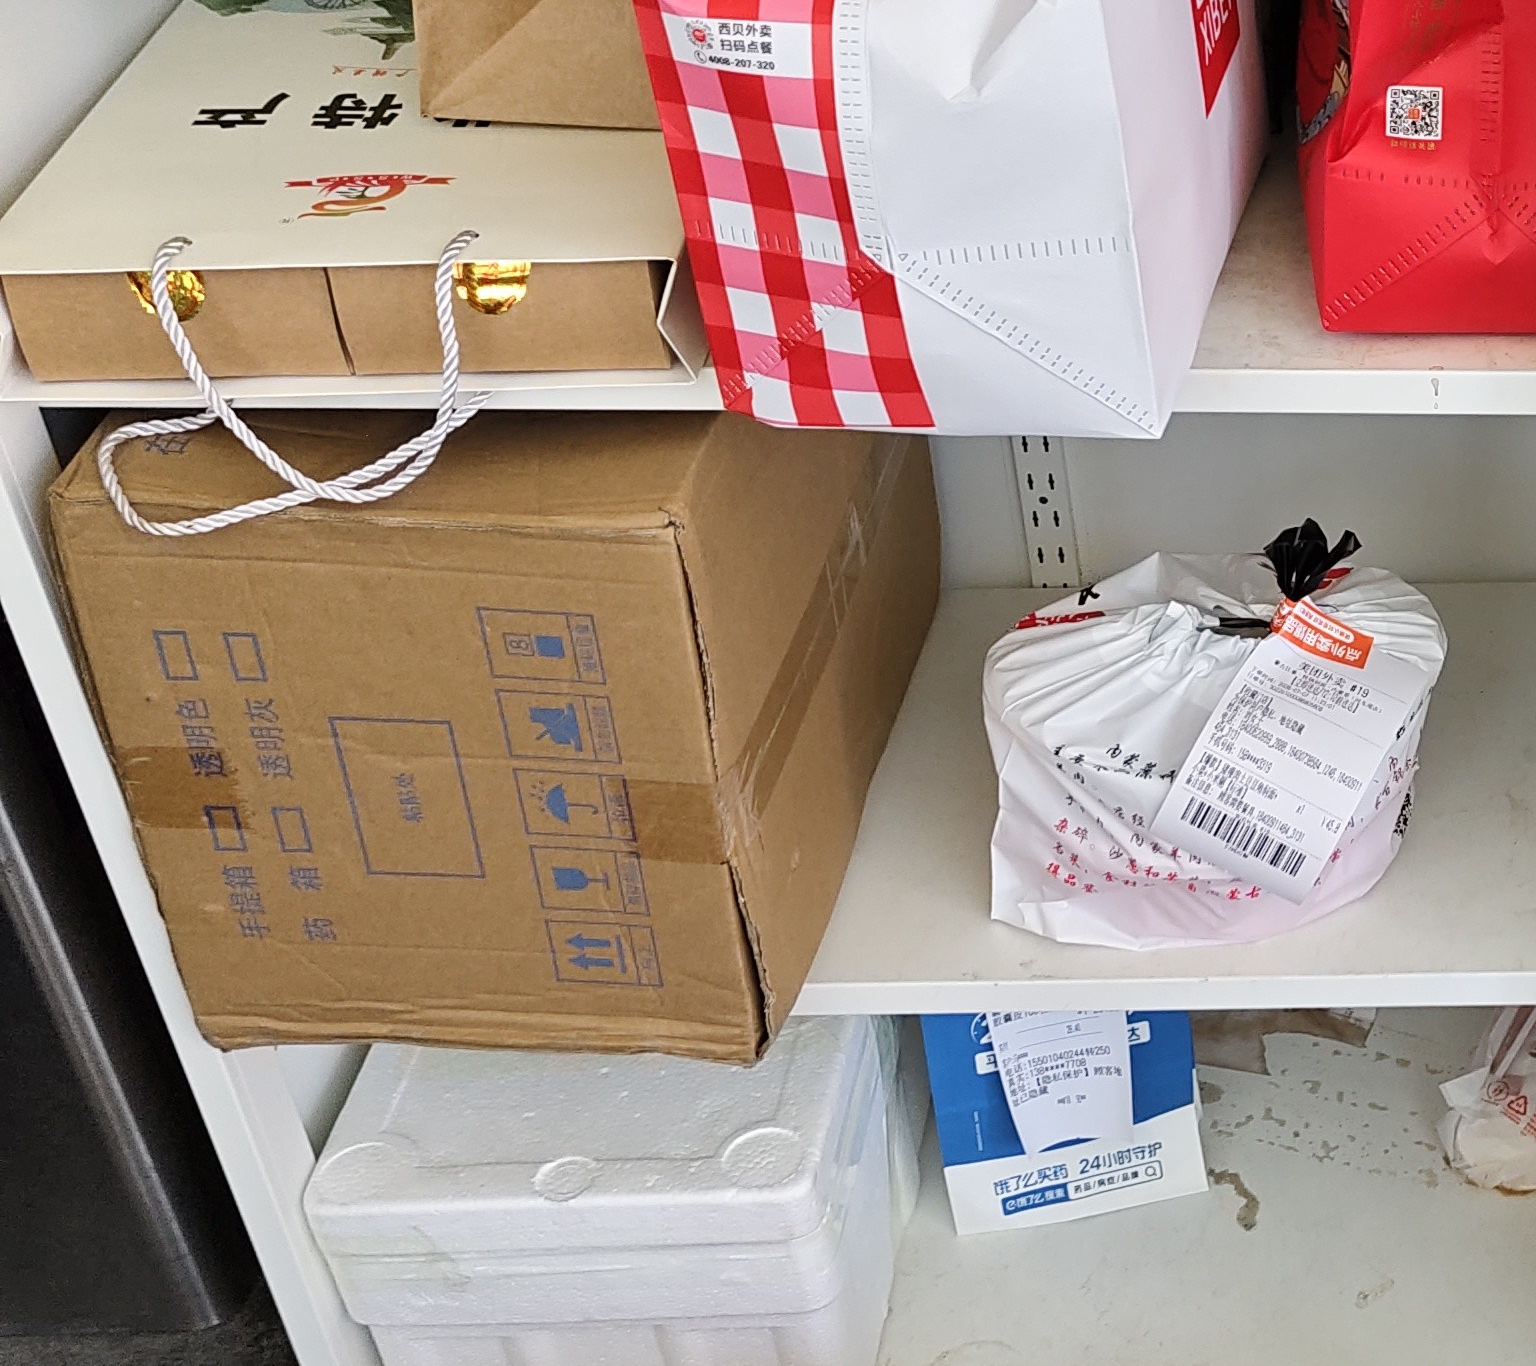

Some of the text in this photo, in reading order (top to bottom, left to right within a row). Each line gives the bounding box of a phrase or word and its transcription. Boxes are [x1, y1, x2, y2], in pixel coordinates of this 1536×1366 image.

[718, 22, 772, 37] 西贝外卖
[721, 40, 772, 54] 扫码点餐
[1297, 658, 1347, 691] 美团外卖
[1349, 682, 1370, 699] #19
[223, 865, 272, 940] 手提箱
[994, 1142, 1162, 1196] 饿了么买药 24小时守护
